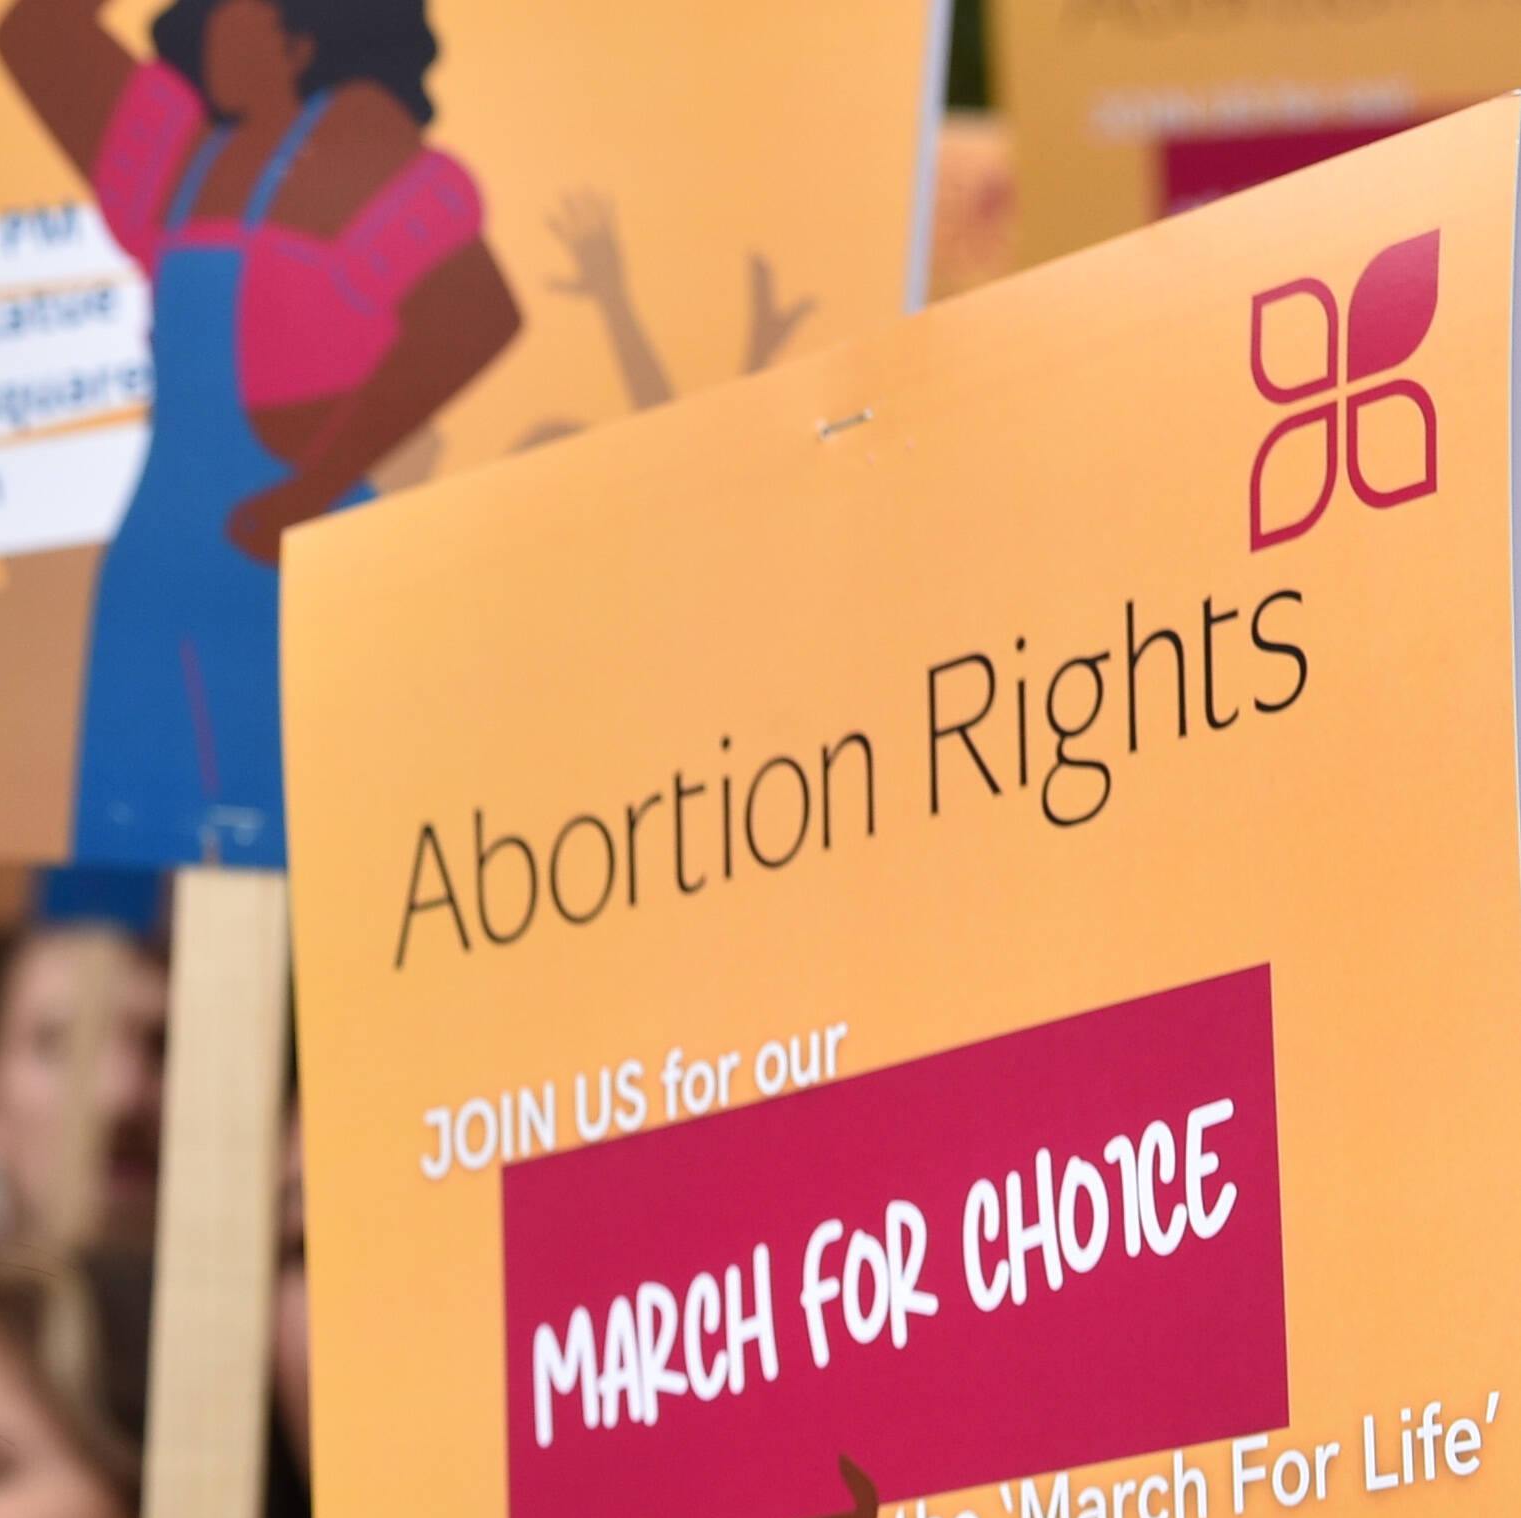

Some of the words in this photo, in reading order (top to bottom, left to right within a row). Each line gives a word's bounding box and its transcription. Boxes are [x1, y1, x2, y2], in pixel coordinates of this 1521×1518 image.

[3, 197, 83, 253] PM
[393, 730, 876, 971] Abortion
[926, 588, 1309, 829] Rights
[420, 1083, 556, 1179] JOIN
[574, 1060, 648, 1140] US
[659, 1045, 740, 1120] for
[754, 1022, 849, 1098] our
[532, 1243, 779, 1450] MARCH
[799, 1200, 940, 1369] FOR
[961, 1097, 1239, 1315] CHOICE
[1229, 1431, 1342, 1517] For
[1361, 1390, 1504, 1492] Life'
